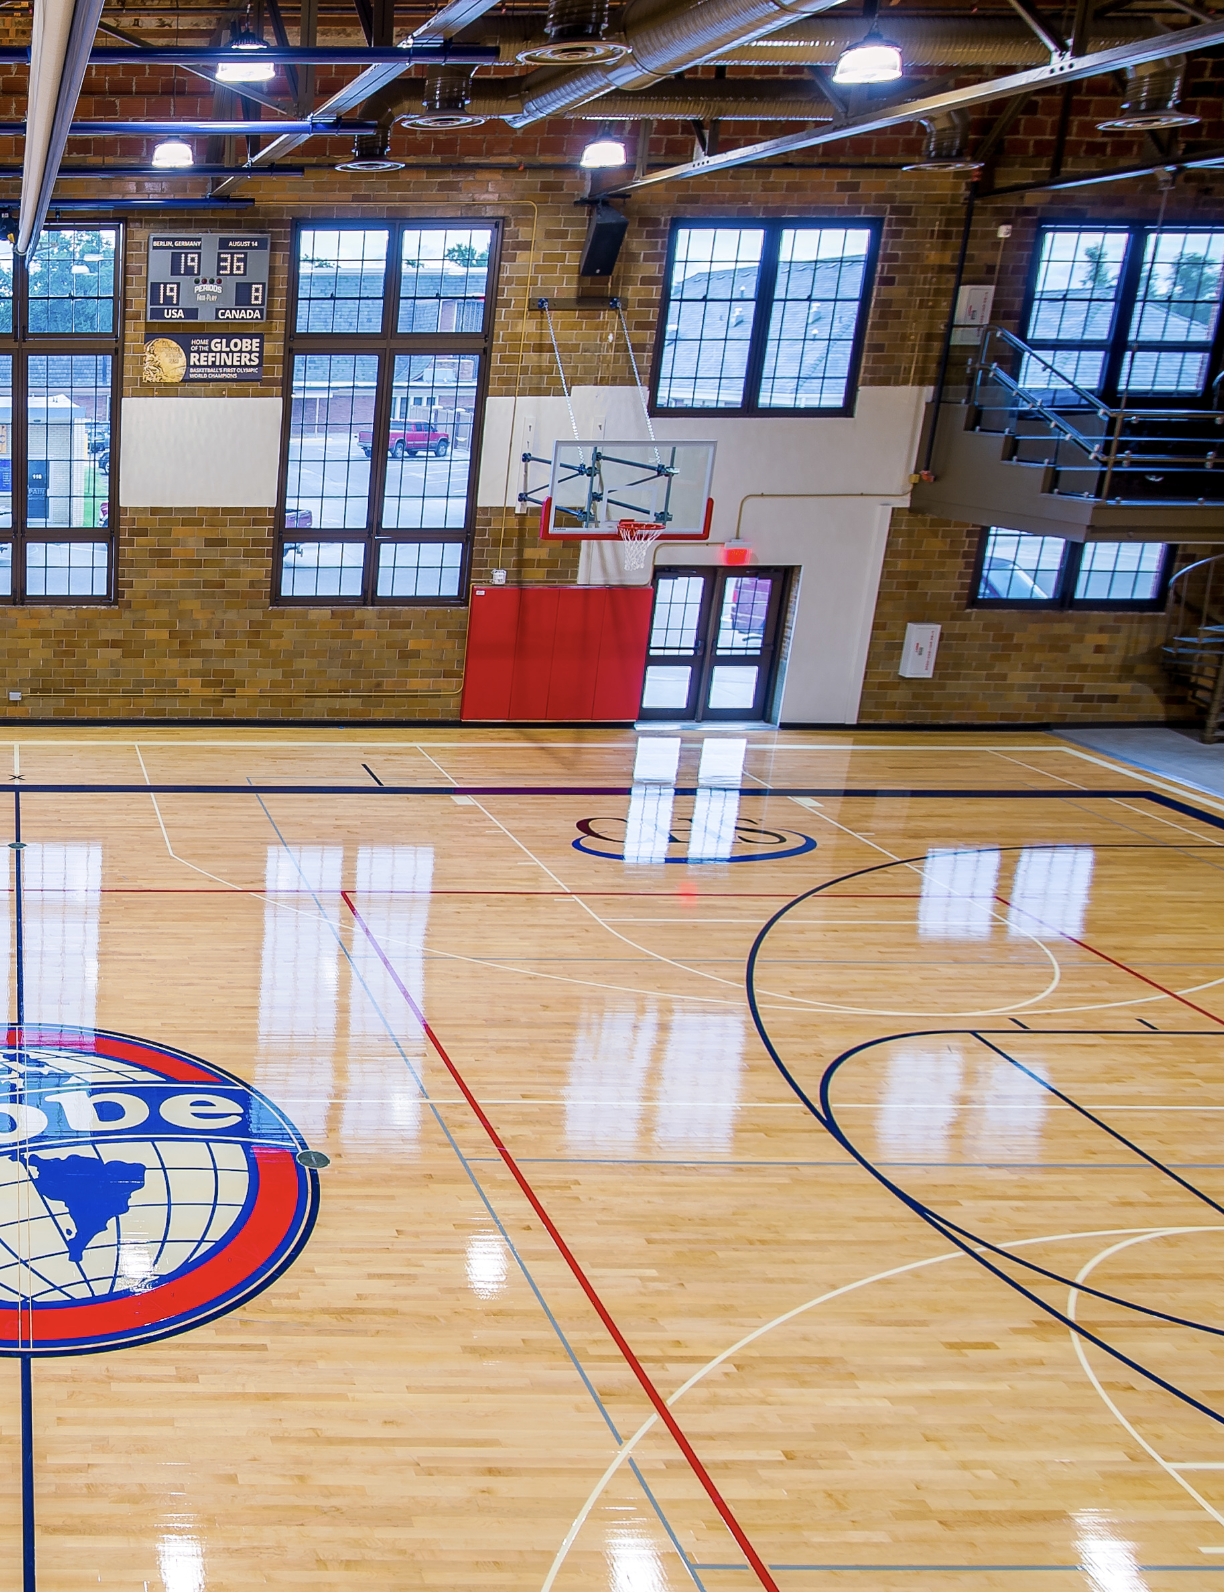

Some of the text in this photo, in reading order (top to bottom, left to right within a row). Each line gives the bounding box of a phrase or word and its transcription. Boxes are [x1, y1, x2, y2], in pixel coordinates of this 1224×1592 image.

[180, 253, 245, 274] 19 36
[159, 284, 177, 304] 19
[194, 284, 223, 293] PERIODS
[251, 284, 263, 304] 8
[164, 309, 185, 319] USA
[218, 309, 261, 319] CANADA
[210, 338, 260, 351] GLOBE
[189, 352, 260, 366] REFINERS
